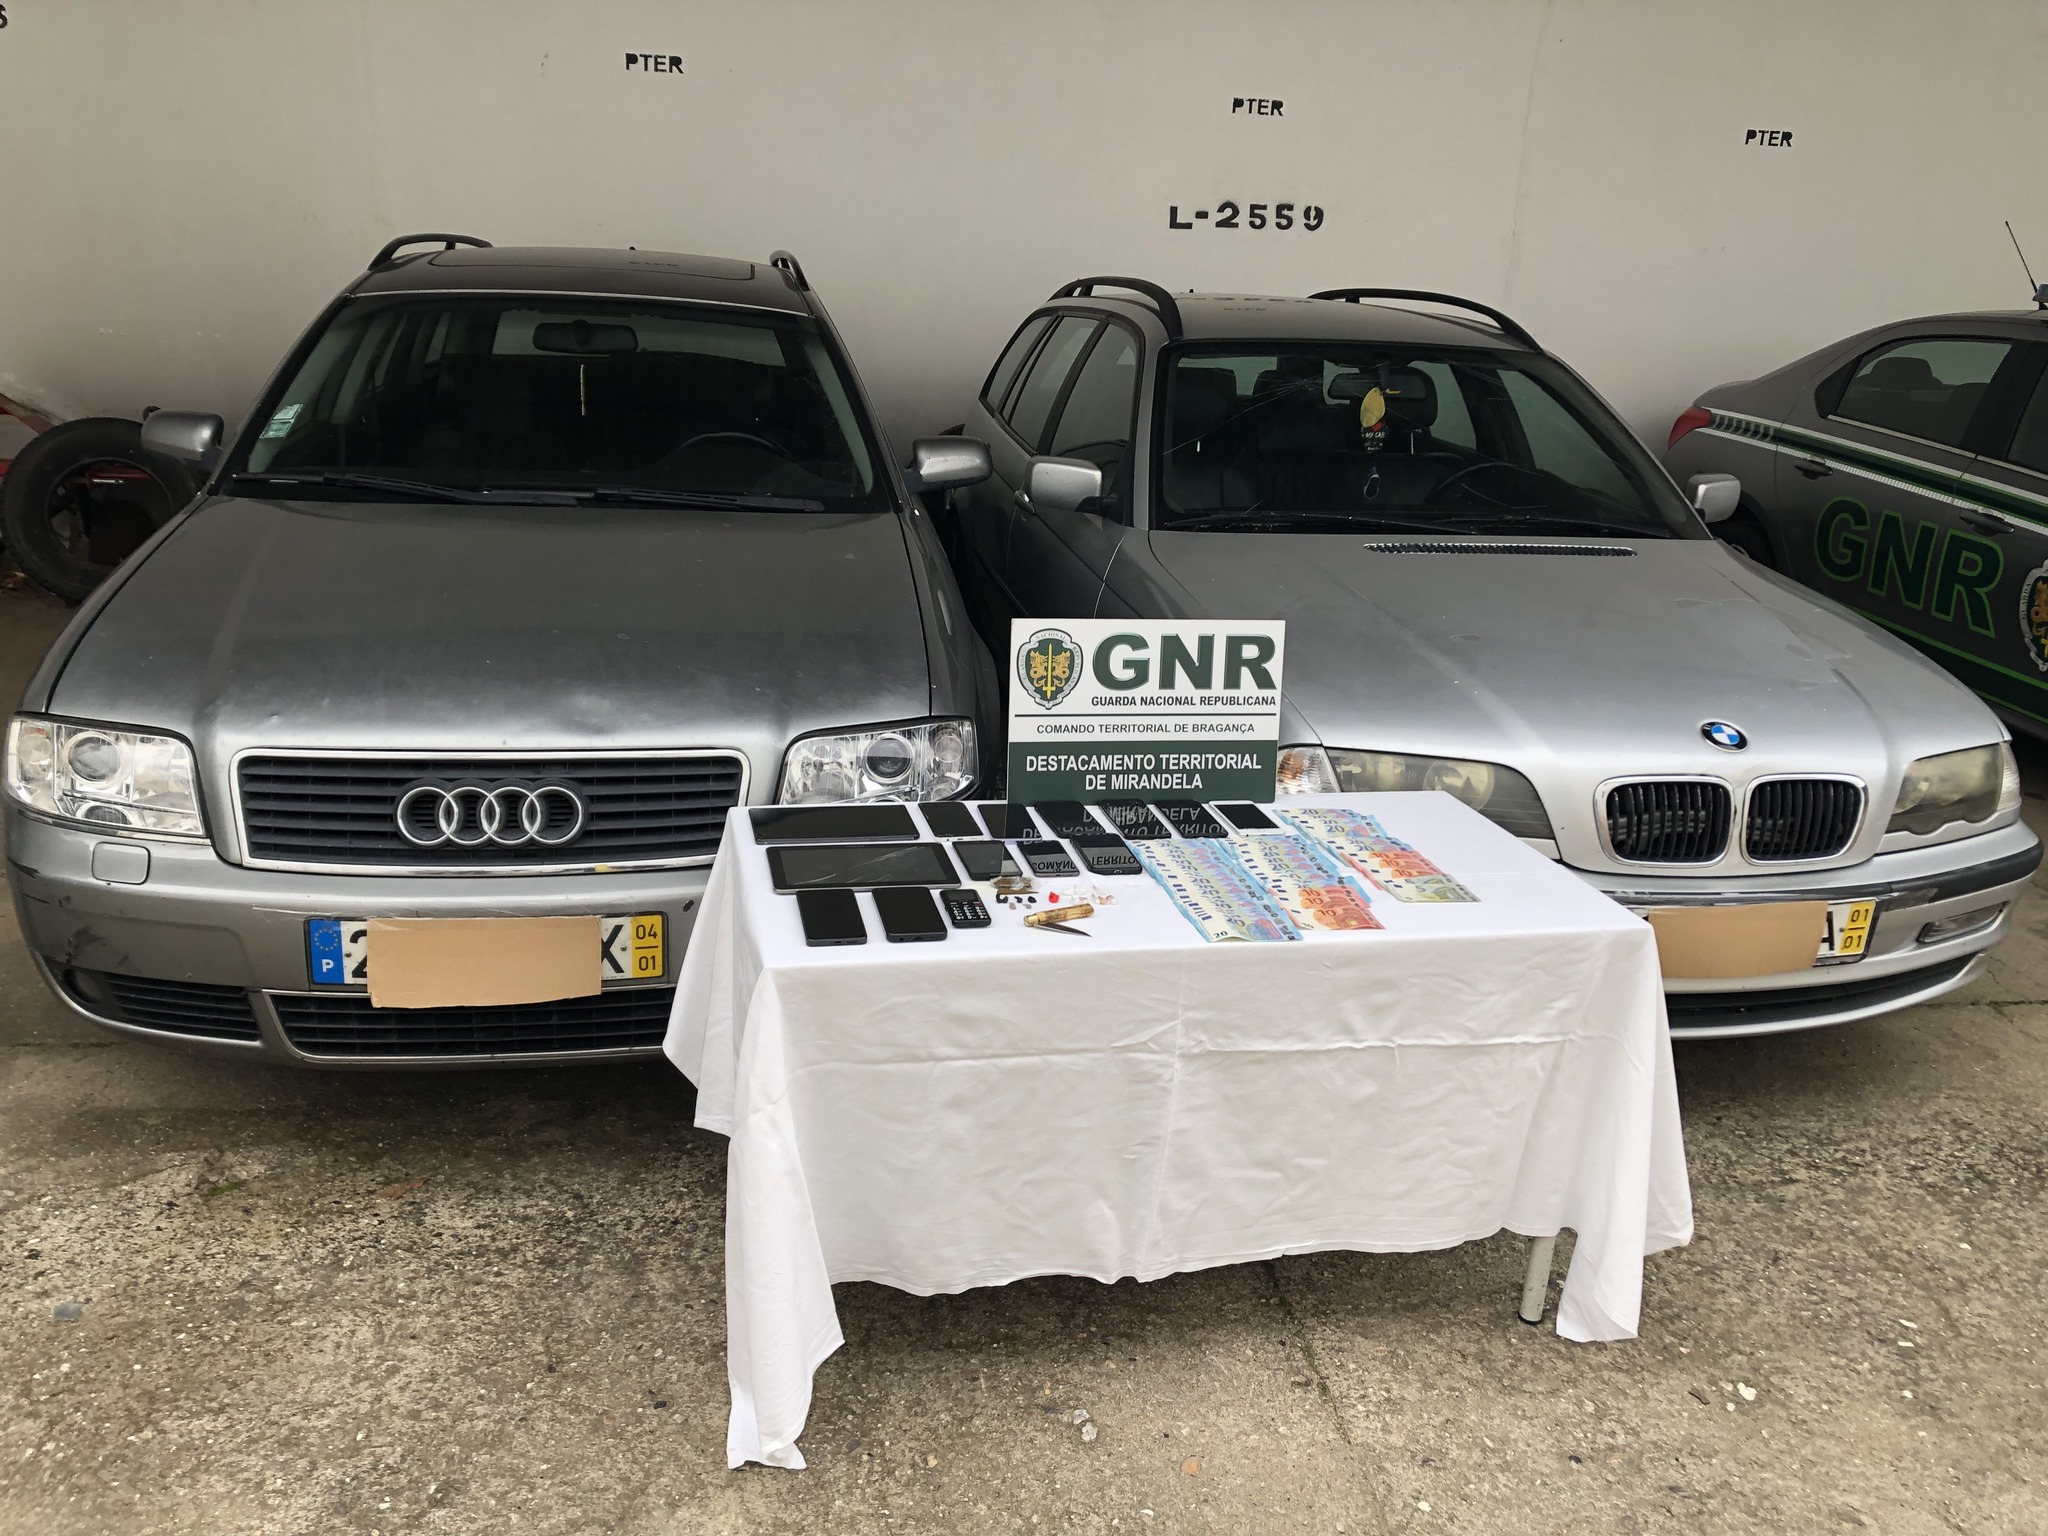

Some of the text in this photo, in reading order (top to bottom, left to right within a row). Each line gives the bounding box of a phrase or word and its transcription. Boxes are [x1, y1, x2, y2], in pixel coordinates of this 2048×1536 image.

[625, 52, 684, 75] PTER
[1231, 97, 1284, 117] PTER
[1744, 128, 1793, 148] PTER
[1168, 199, 1325, 232] L-2559
[1814, 496, 2005, 639] GNR
[1092, 631, 1278, 692] GNR
[1091, 695, 1277, 707] GUARDA NACIONAL REPUBLICANA
[1036, 723, 1255, 735] COMANDO TERRITORIAL DE BRAGANÇA
[1026, 753, 1262, 772] DESTACAMENTO TERRITORIAL
[1085, 773, 1203, 791] DE MIRANDELA
[1325, 825, 1345, 833] 20
[1382, 859, 1400, 867] 10
[1394, 869, 1413, 877] 10
[1302, 889, 1321, 897] 10
[1317, 909, 1337, 917] 10
[1851, 908, 1870, 923] 01
[635, 923, 658, 940] 04
[1843, 934, 1863, 949] 01
[321, 958, 334, 973] P
[638, 955, 656, 972] 01
